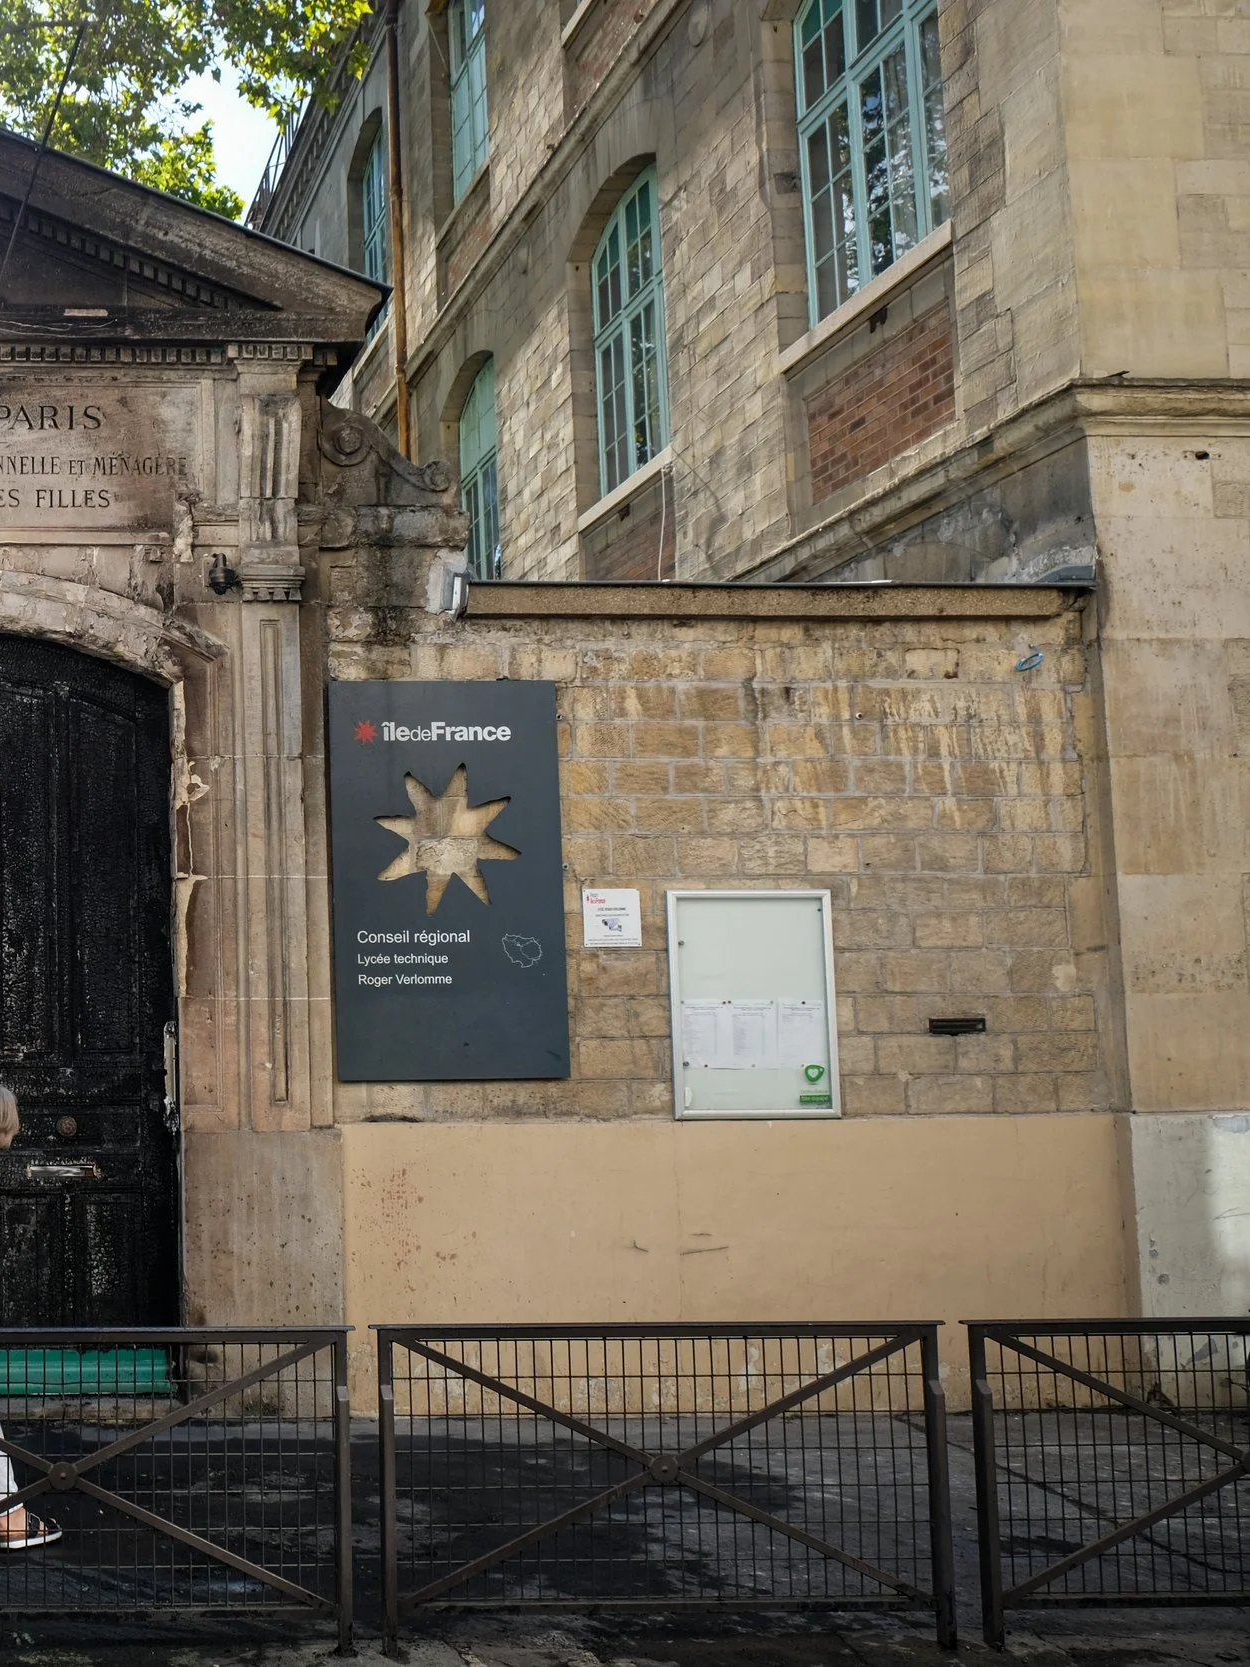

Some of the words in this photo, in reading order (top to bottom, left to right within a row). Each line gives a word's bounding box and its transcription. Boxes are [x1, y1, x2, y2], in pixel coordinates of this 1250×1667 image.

[68, 459, 86, 476] ET
[35, 488, 112, 509] FILLES
[357, 930, 410, 944] Conseil
[414, 929, 471, 946] régional
[357, 953, 391, 967] Lycée
[393, 953, 449, 966] technique
[358, 974, 393, 988] Roger
[395, 973, 453, 985] Verlomme
